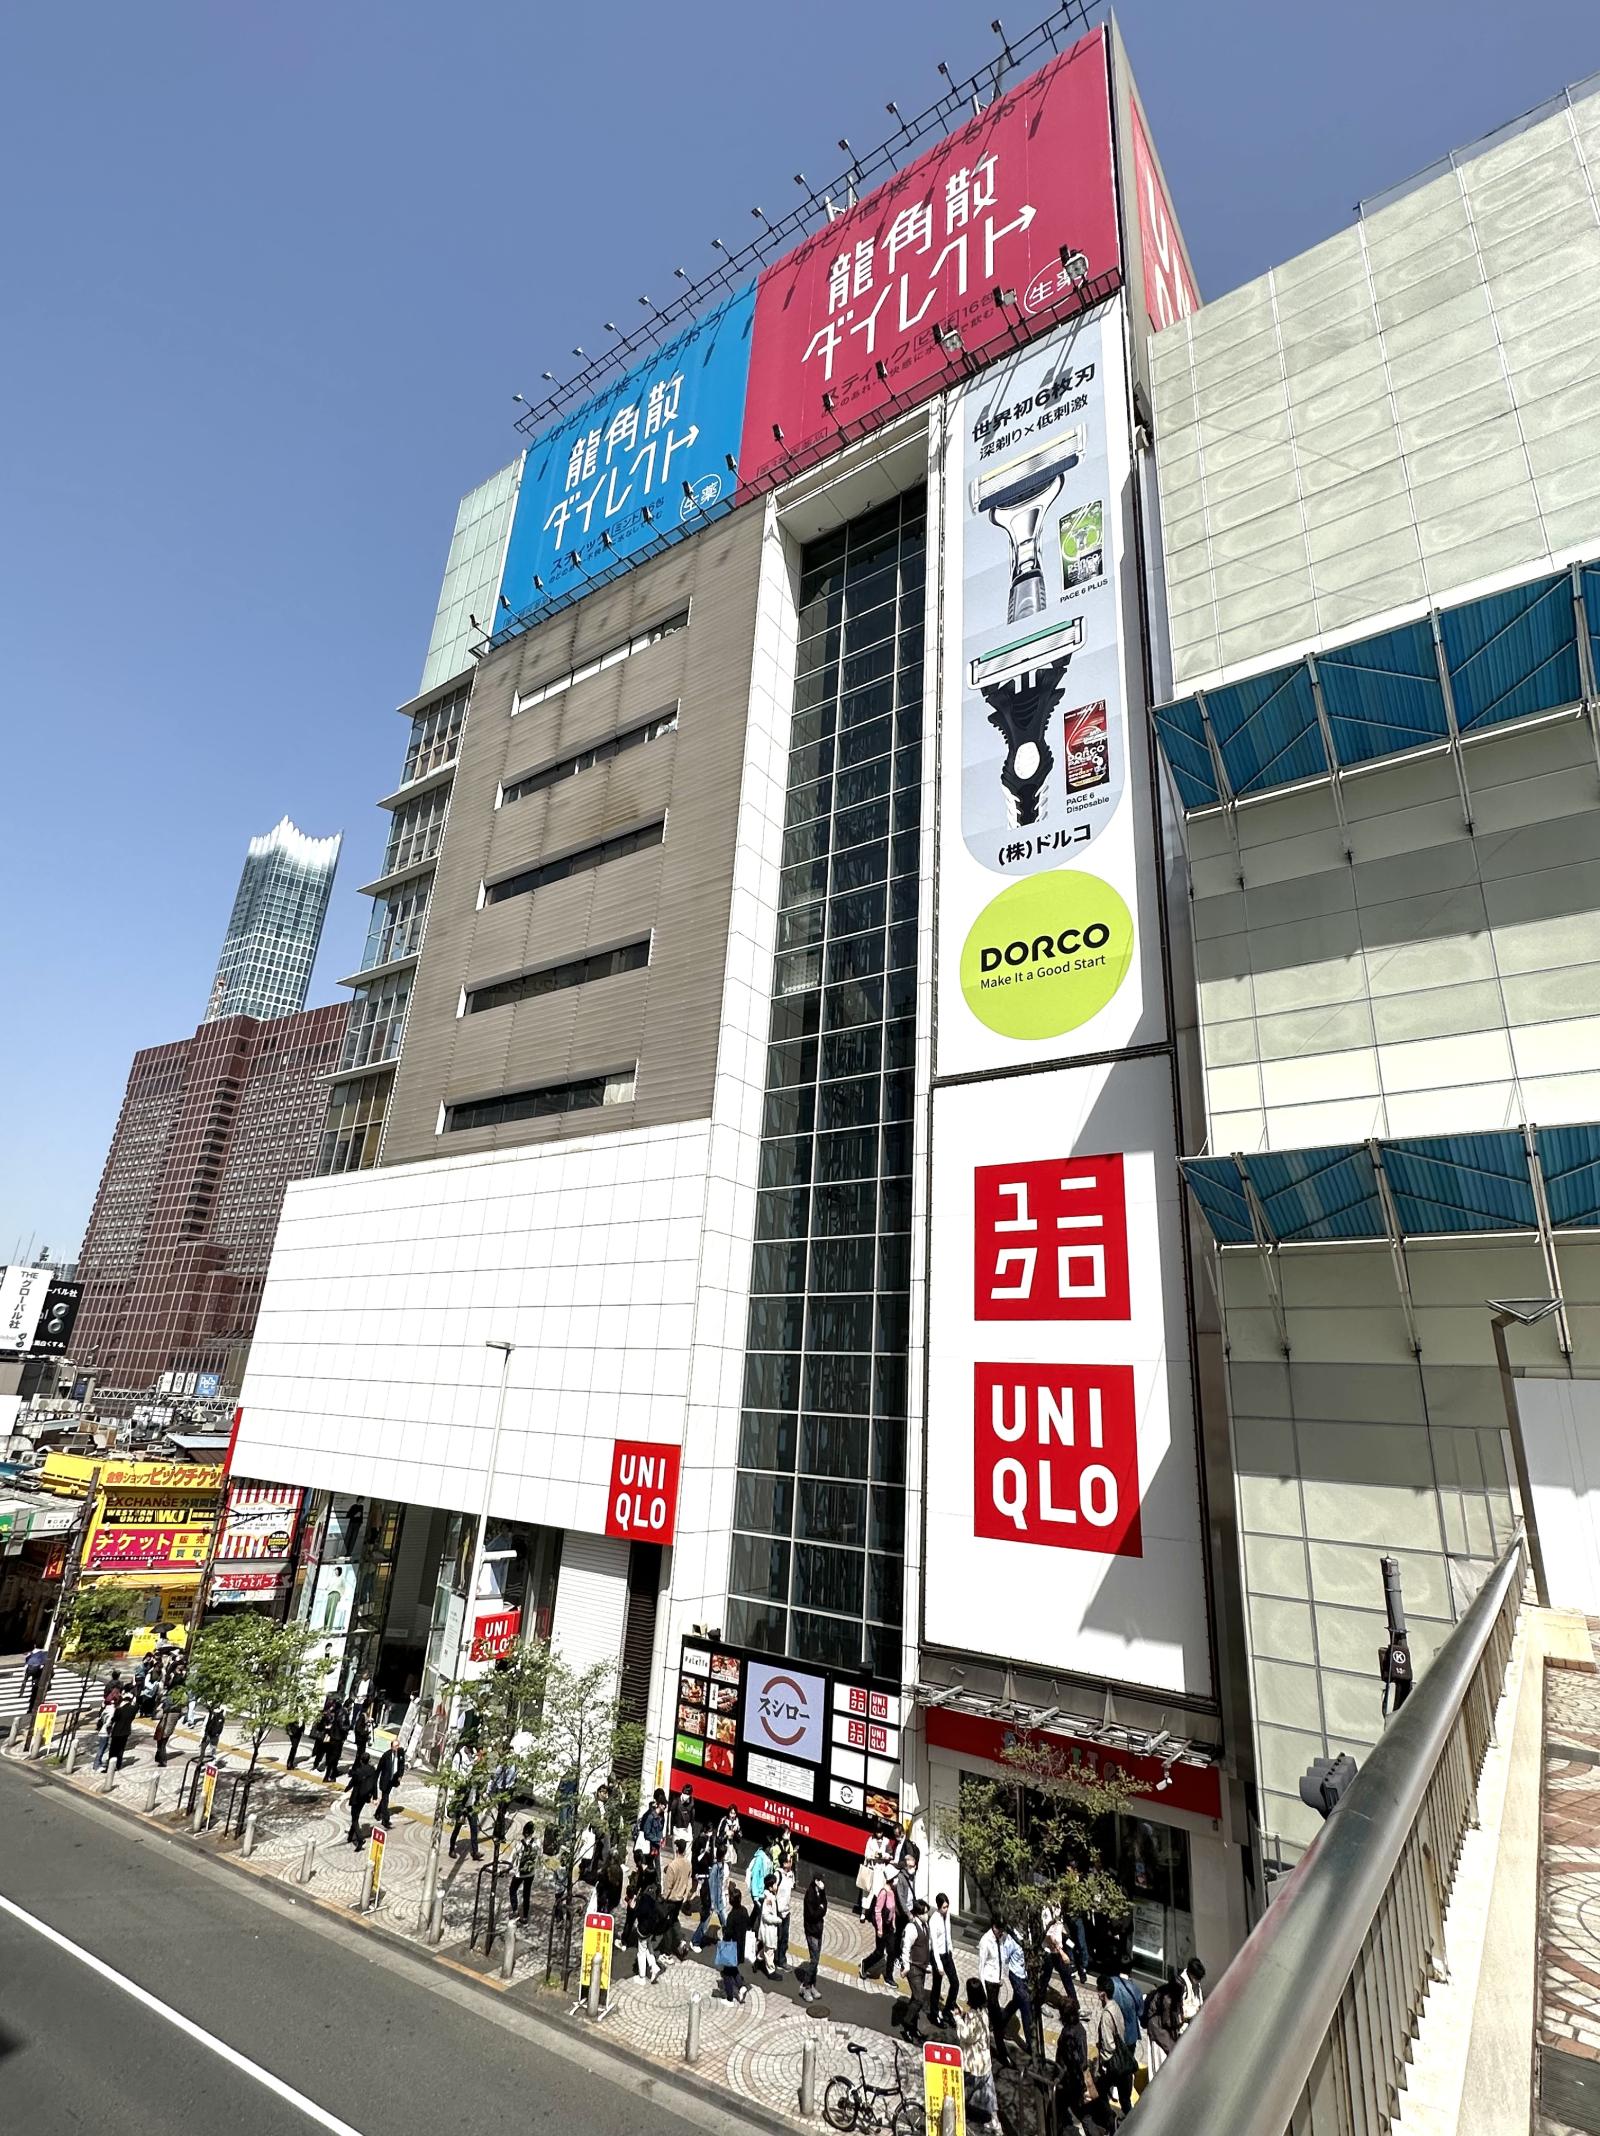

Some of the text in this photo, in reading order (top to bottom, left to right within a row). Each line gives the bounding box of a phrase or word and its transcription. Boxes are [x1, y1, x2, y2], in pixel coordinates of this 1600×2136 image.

[828, 151, 999, 315] 龍角散
[801, 204, 1037, 381] ダイレクト
[972, 363, 1096, 444] 世界初6枚刃
[564, 369, 685, 492] 龍角散
[979, 393, 1089, 461] 深剃り×低刺激
[543, 424, 699, 551] ダイレクト
[683, 481, 719, 516] 生薬
[1060, 579, 1109, 603] PACE 6 PLUS
[1066, 791, 1095, 807] PACE 6
[1066, 796, 1110, 815] Disposable
[998, 824, 1091, 866] (株)ドルコ
[980, 923, 1110, 972] DORCO
[980, 954, 1106, 990] Make It a Good Start
[994, 1175, 1104, 1233] ユニ
[21, 1270, 39, 1280] THE
[990, 1244, 1107, 1300] クロ
[991, 1384, 1104, 1449] UNI
[619, 1454, 666, 1491] UNI
[106, 1497, 178, 1507] EXCHANGE
[615, 1492, 666, 1532] QLO
[991, 1457, 1119, 1531] QLO
[107, 1509, 153, 1517] WESTERN
[96, 1533, 171, 1551] チケット
[485, 1619, 508, 1638] UNI
[757, 1697, 810, 1720] スシロー
[872, 1695, 885, 1706] UNI
[872, 1705, 886, 1716] QLO
[871, 1728, 884, 1739] UNI
[871, 1738, 885, 1749] QLO
